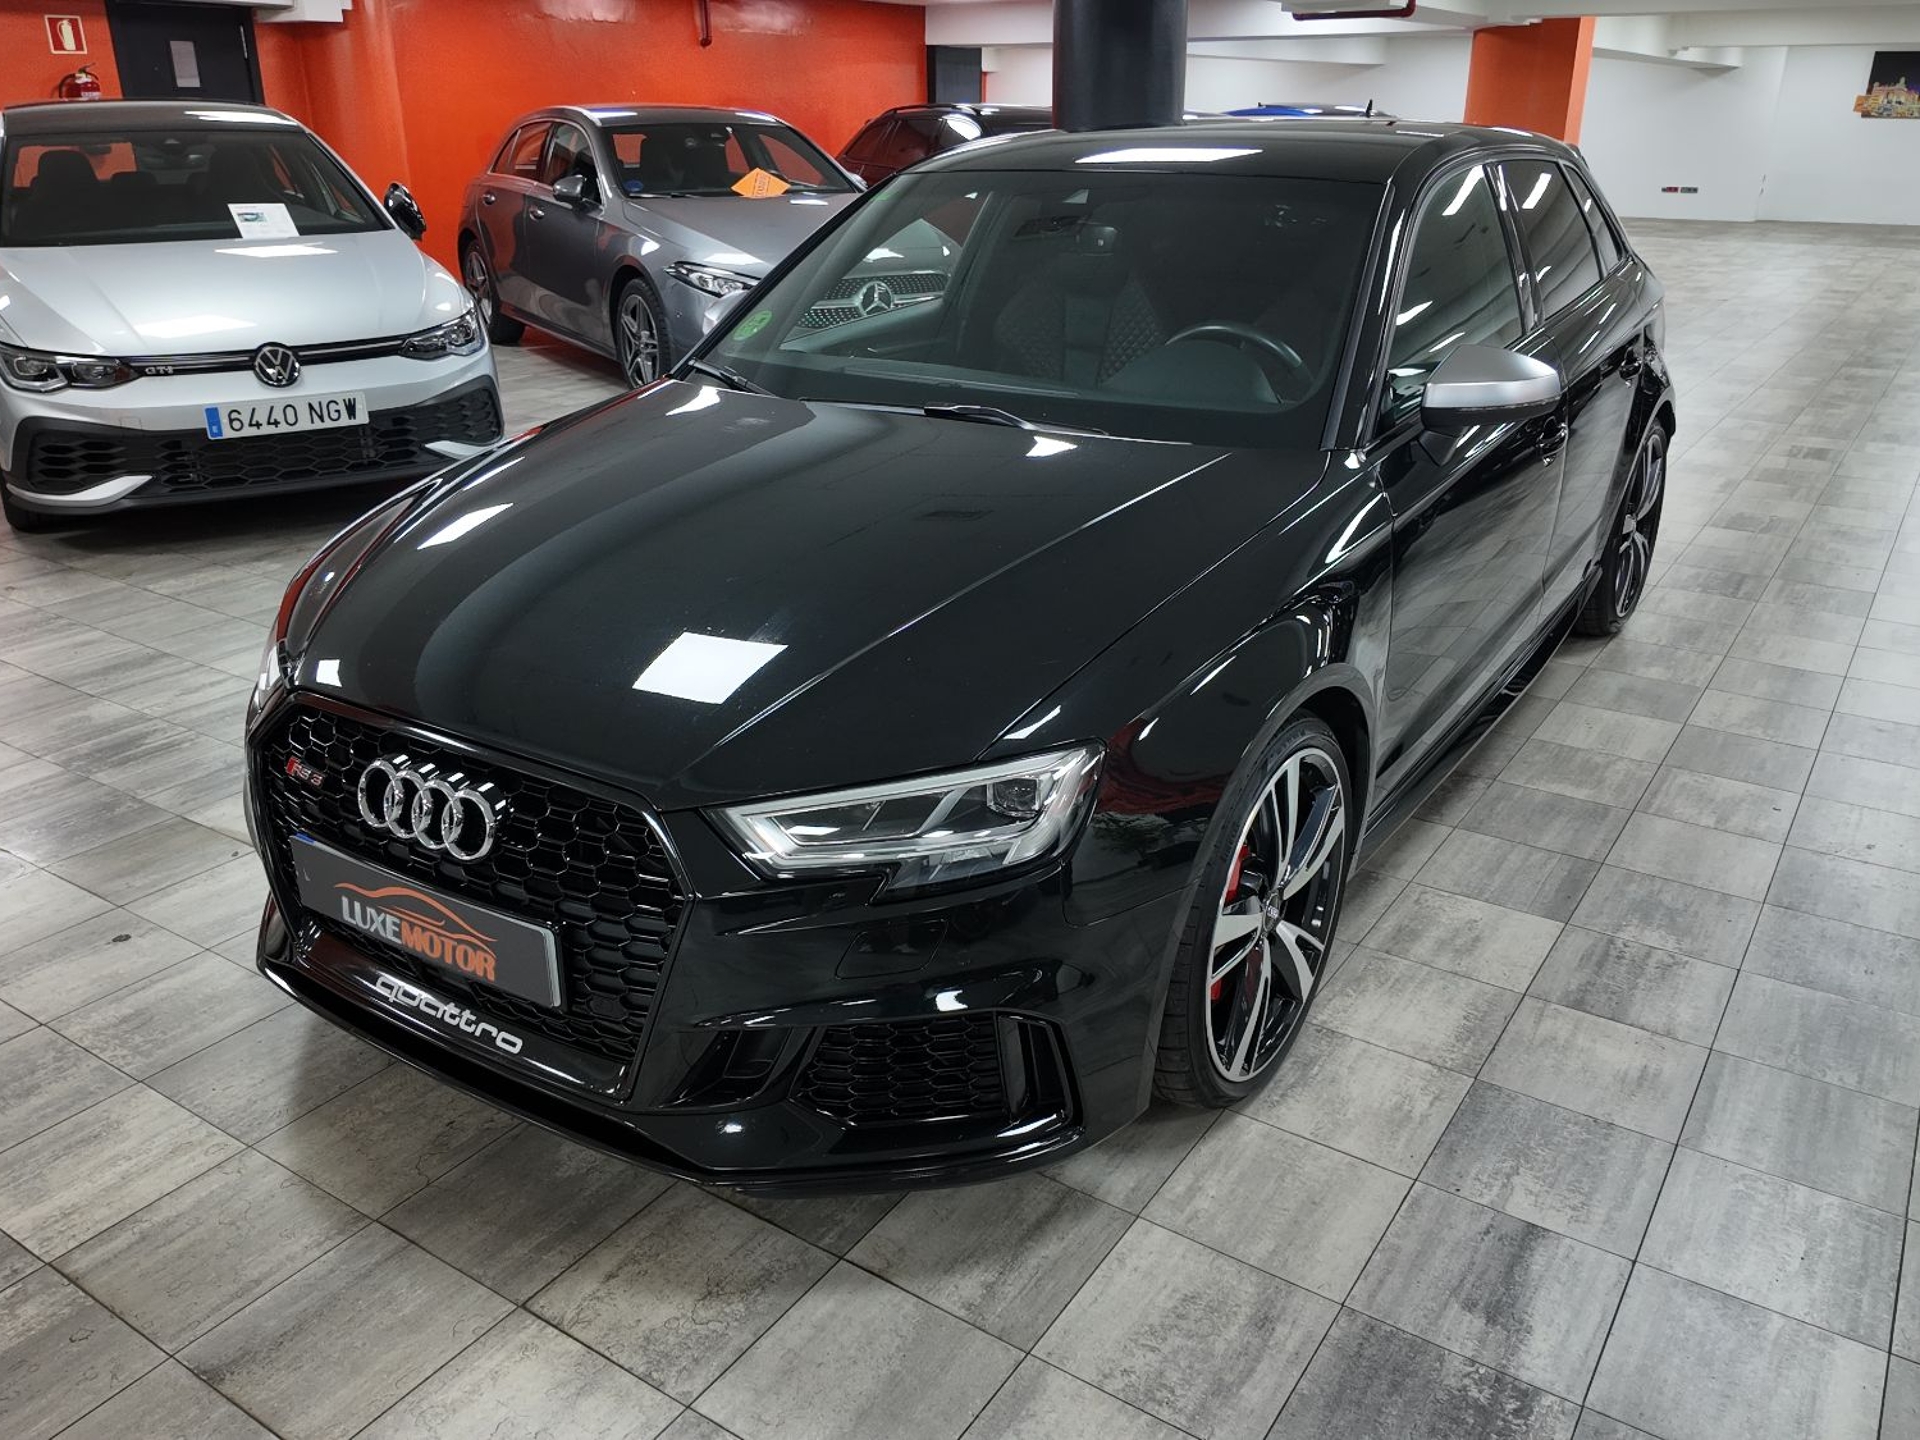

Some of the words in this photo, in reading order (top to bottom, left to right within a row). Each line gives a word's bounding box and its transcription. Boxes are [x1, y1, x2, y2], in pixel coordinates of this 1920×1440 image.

[145, 365, 174, 375] GTI
[227, 404, 299, 432] 6440
[308, 397, 357, 424] NGW
[341, 895, 497, 983] LUXEMOTOR
[375, 974, 524, 1056] quattro
